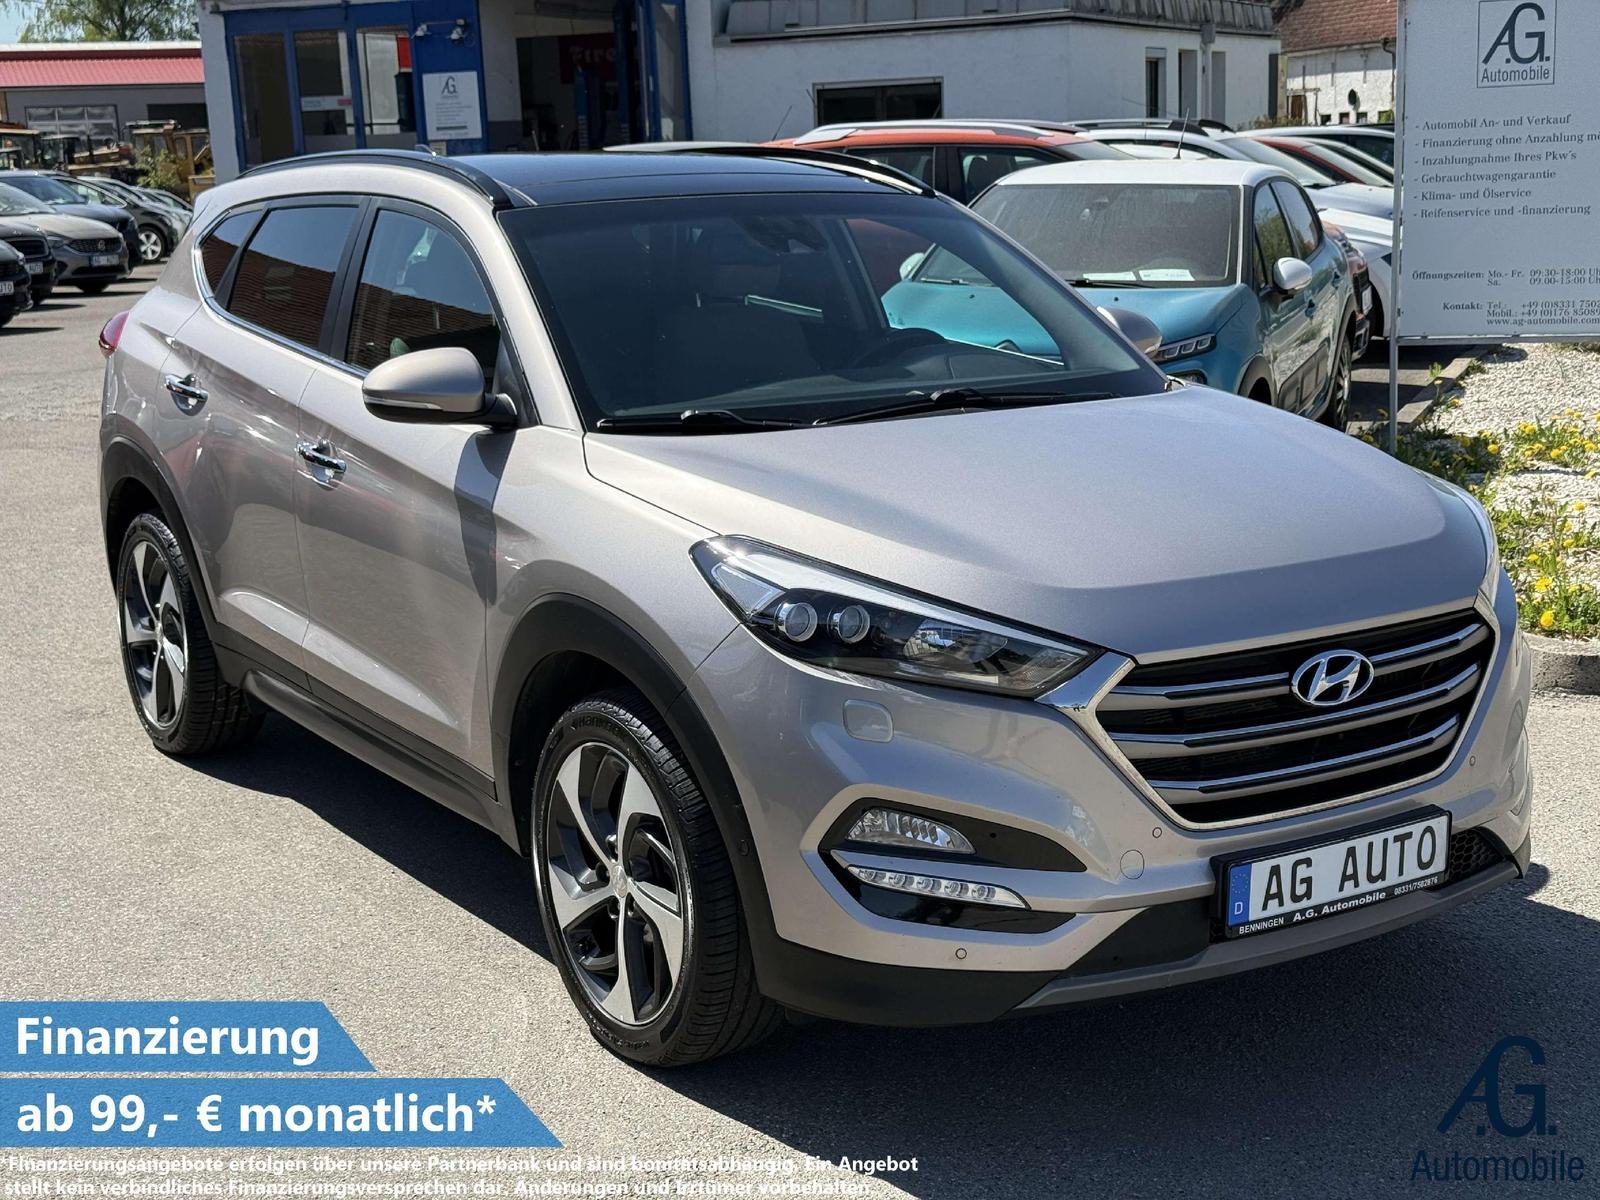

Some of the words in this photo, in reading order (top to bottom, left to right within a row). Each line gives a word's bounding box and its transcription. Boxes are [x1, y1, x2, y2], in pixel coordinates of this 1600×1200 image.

[1481, 66, 1550, 83] Automobile
[1422, 118, 1477, 131] Automobil
[1480, 118, 1500, 128] An-
[1503, 116, 1523, 127] und
[1527, 113, 1572, 126] Verkauf
[1422, 136, 1492, 149] Finanzierung
[1496, 134, 1522, 145] ohne
[1525, 132, 1584, 144] Anzahlung
[1422, 152, 1511, 166] Inzahlungnahme
[1514, 151, 1542, 162] Ihres
[1421, 169, 1556, 184] Gebrauchtwagengarantie
[1421, 191, 1456, 201] Klima-
[1460, 189, 1479, 200] und
[1483, 187, 1531, 199] Ölservice
[1420, 206, 1490, 219] Reifenservice
[1494, 206, 1514, 216] und
[1518, 204, 1591, 216] -finanzierung
[1412, 269, 1484, 281] Öffnungszeiten:
[1442, 301, 1483, 311] Kontakt:
[1521, 301, 1538, 309] +49
[1521, 309, 1538, 317] +49
[1487, 317, 1600, 327] www.ag-automobile.com
[1261, 857, 1313, 911] AG
[1338, 825, 1437, 893] AUTO
[1234, 902, 1243, 915] D
[1239, 916, 1284, 934] BENNINGEN
[1293, 909, 1318, 922] A.G.
[1322, 890, 1387, 914] Automobile
